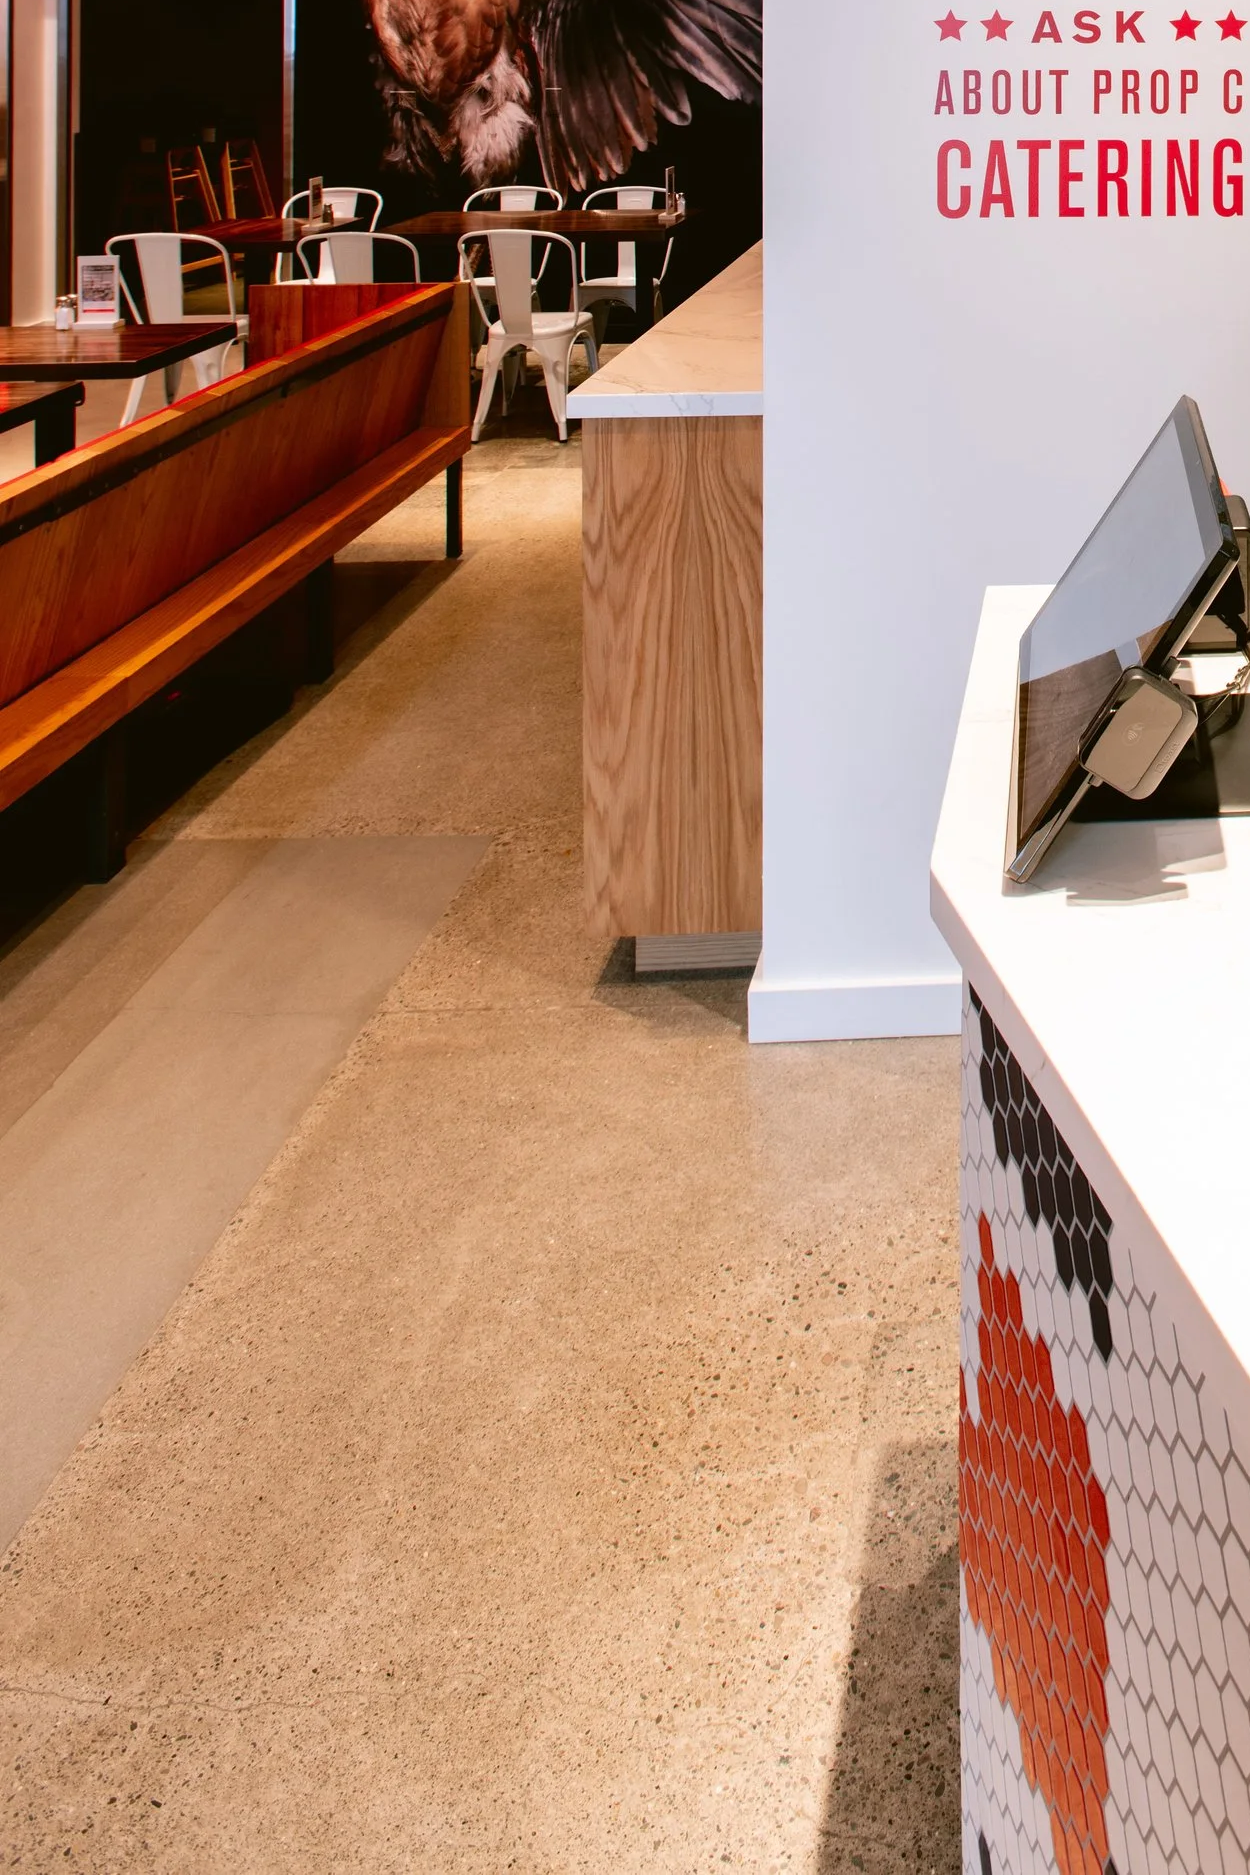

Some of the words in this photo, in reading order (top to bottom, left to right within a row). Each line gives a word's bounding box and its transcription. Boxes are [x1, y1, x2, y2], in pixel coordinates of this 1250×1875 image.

[1031, 10, 1146, 44] ASK
[934, 69, 1069, 115] ABOUT
[1093, 69, 1199, 115] PROP
[1223, 68, 1243, 114] C
[937, 138, 1244, 219] CATERING
